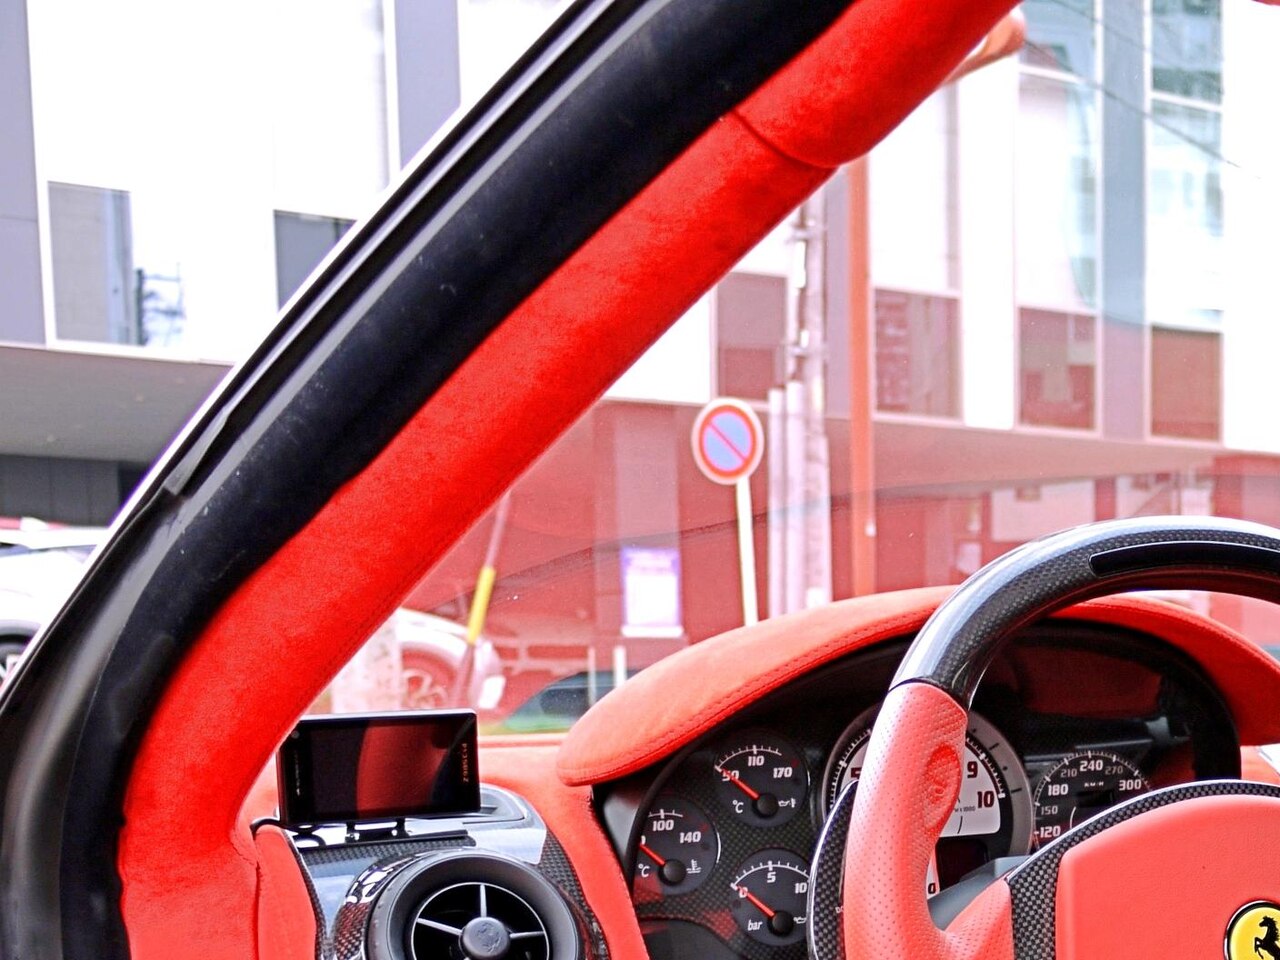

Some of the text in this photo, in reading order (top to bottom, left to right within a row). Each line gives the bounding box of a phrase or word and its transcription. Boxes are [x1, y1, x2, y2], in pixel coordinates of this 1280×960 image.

[748, 755, 764, 767] 110
[1079, 760, 1103, 772] 240
[773, 767, 793, 778] 170
[967, 760, 978, 779] 9
[1060, 767, 1078, 778] 210
[1104, 763, 1123, 775] 270
[722, 770, 739, 782] 50
[1047, 783, 1069, 796] 180
[1118, 779, 1142, 791] 300
[977, 790, 995, 809] 10
[1040, 805, 1059, 816] 150
[652, 820, 674, 831] 100
[1040, 825, 1061, 838] 120
[679, 831, 701, 843] 140
[767, 872, 777, 883] 5
[794, 882, 807, 894] 10
[747, 919, 763, 931] bar
